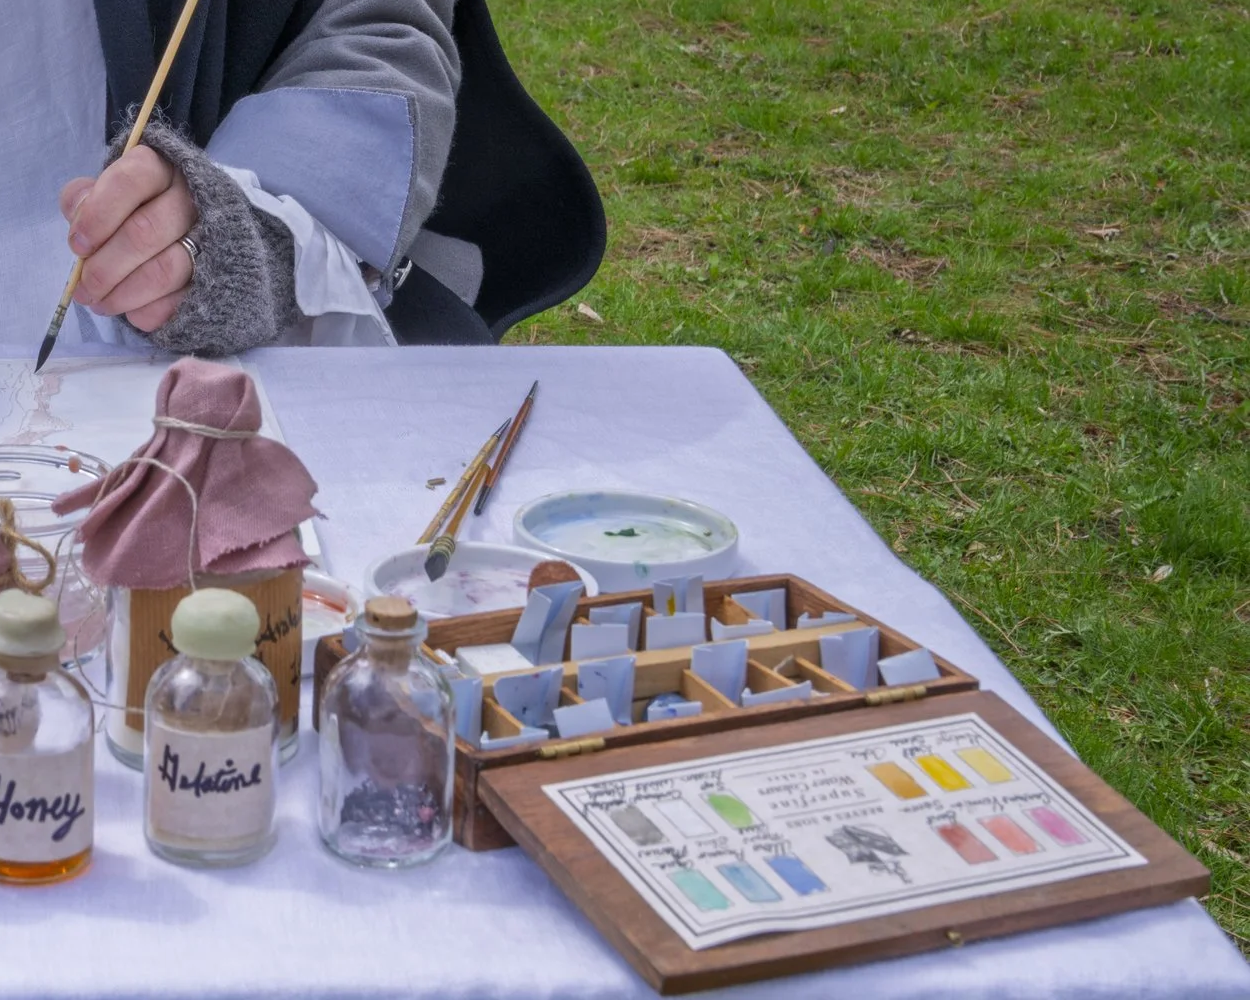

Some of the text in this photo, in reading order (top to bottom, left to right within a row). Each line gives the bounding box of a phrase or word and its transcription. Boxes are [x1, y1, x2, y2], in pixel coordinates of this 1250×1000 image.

[158, 743, 262, 798] Gelatine
[767, 772, 807, 782] Cakes
[757, 776, 856, 796] Water Colours
[769, 788, 867, 810] Superfine
[836, 806, 884, 820] REEVES
[785, 818, 819, 829] SONS
